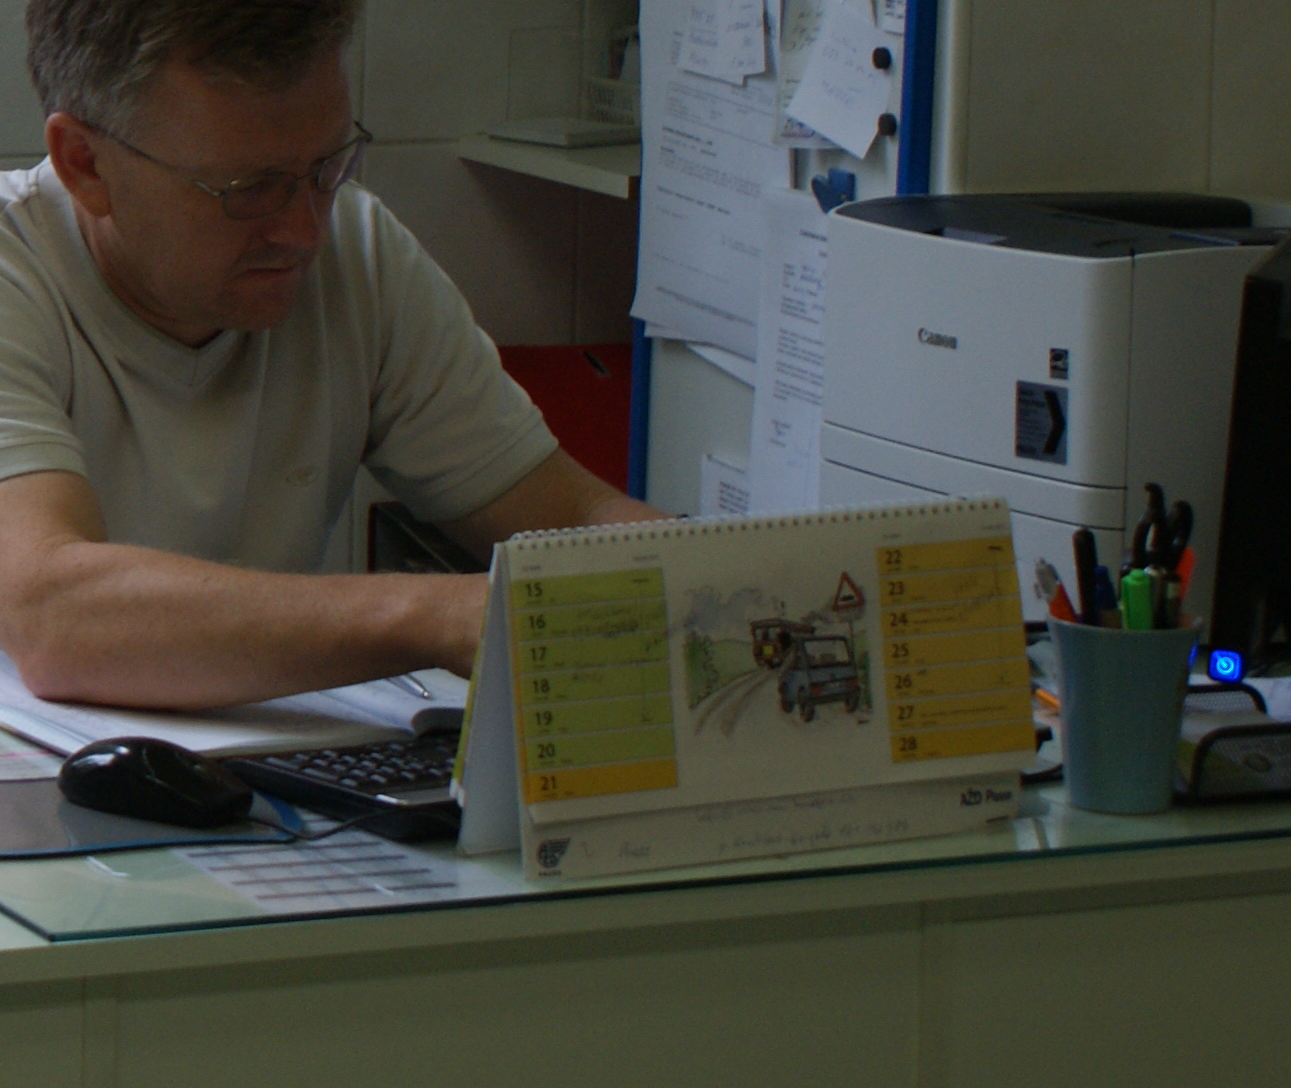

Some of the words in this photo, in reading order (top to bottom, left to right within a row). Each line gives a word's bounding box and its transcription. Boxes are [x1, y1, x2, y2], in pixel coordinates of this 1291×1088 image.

[916, 327, 958, 350] Canon
[885, 550, 902, 565] 22
[525, 583, 543, 597] 15
[887, 581, 904, 596] 23
[529, 614, 546, 629] 16
[890, 613, 908, 627] 24
[530, 646, 547, 661] 17
[892, 643, 909, 658] 25
[532, 679, 550, 693] 18
[895, 674, 912, 689] 26
[535, 711, 552, 726] 19
[897, 706, 914, 720] 27
[537, 743, 555, 758] 20
[899, 737, 917, 751] 28
[540, 776, 557, 790] 21
